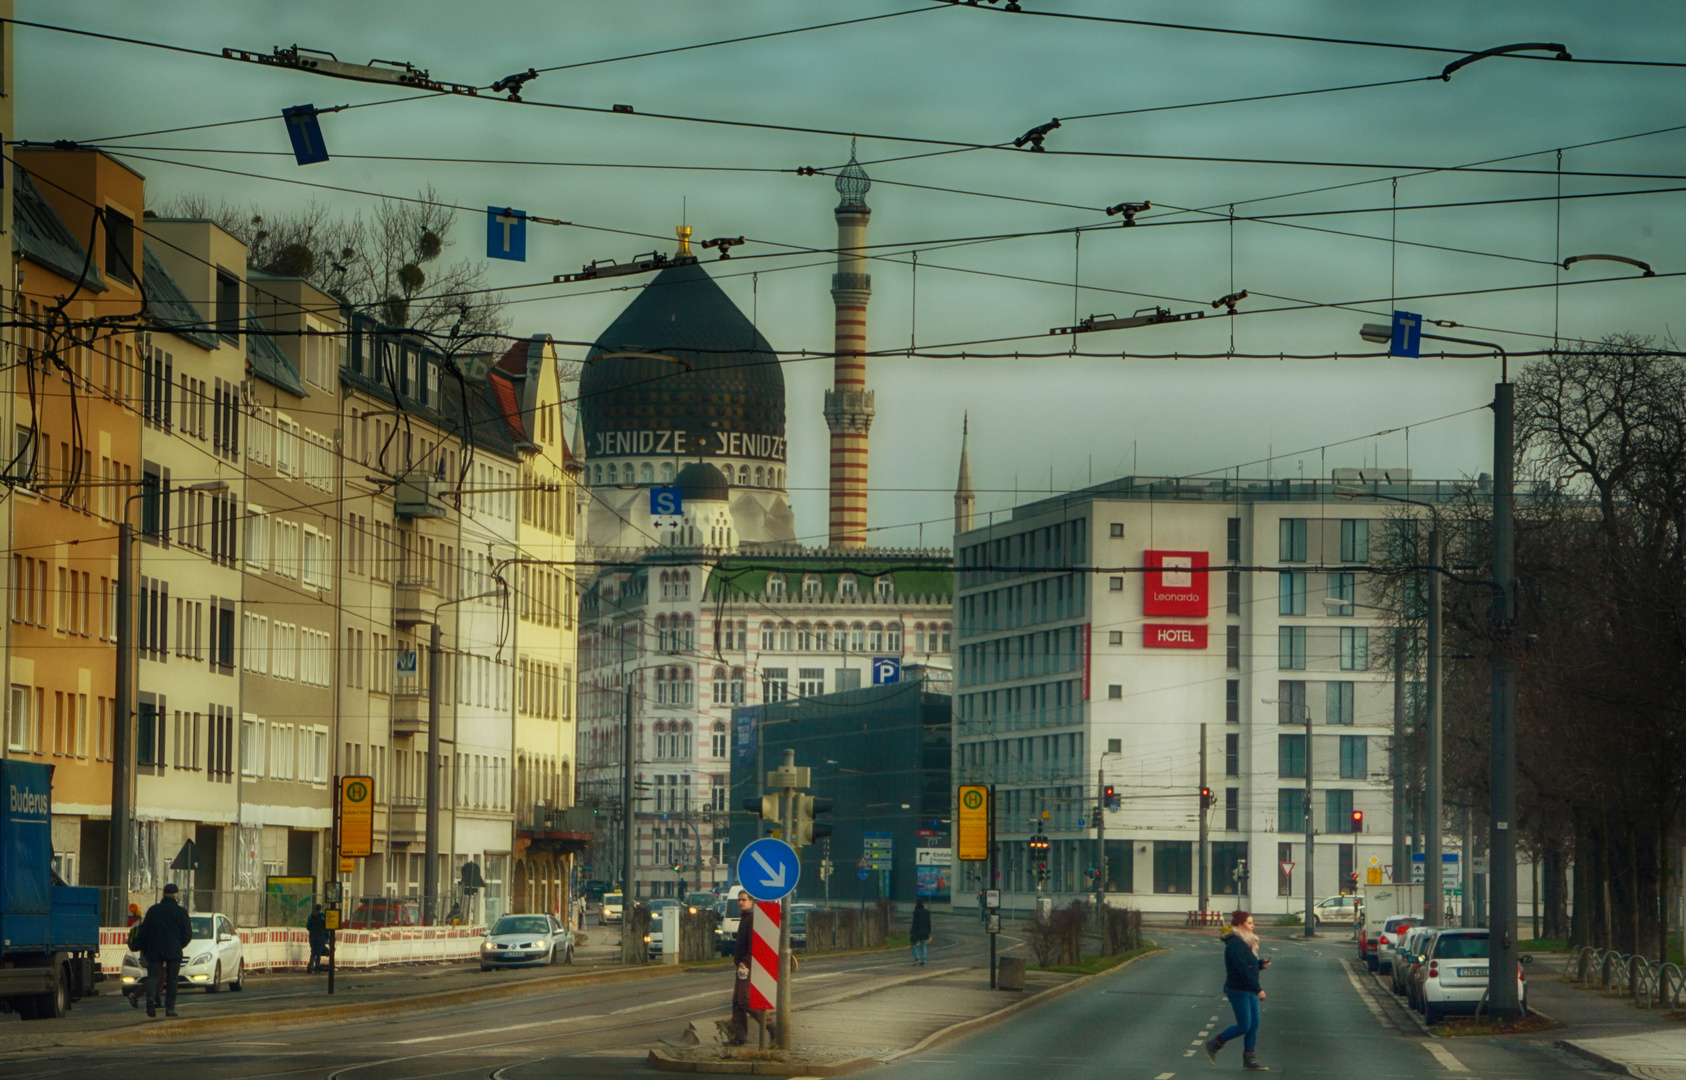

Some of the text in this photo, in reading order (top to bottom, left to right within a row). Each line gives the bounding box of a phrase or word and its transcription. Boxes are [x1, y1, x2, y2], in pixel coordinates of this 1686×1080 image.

[291, 113, 313, 155] T
[496, 215, 518, 252] T
[1400, 318, 1416, 350] T
[595, 430, 784, 460] YENIDZE YENIDZE
[657, 492, 676, 515] S
[1154, 592, 1200, 602] Leonardo
[1158, 629, 1194, 642] HOTEL
[880, 665, 894, 684] P
[10, 784, 48, 815] Buderus
[352, 786, 362, 798] H
[969, 793, 978, 805] H
